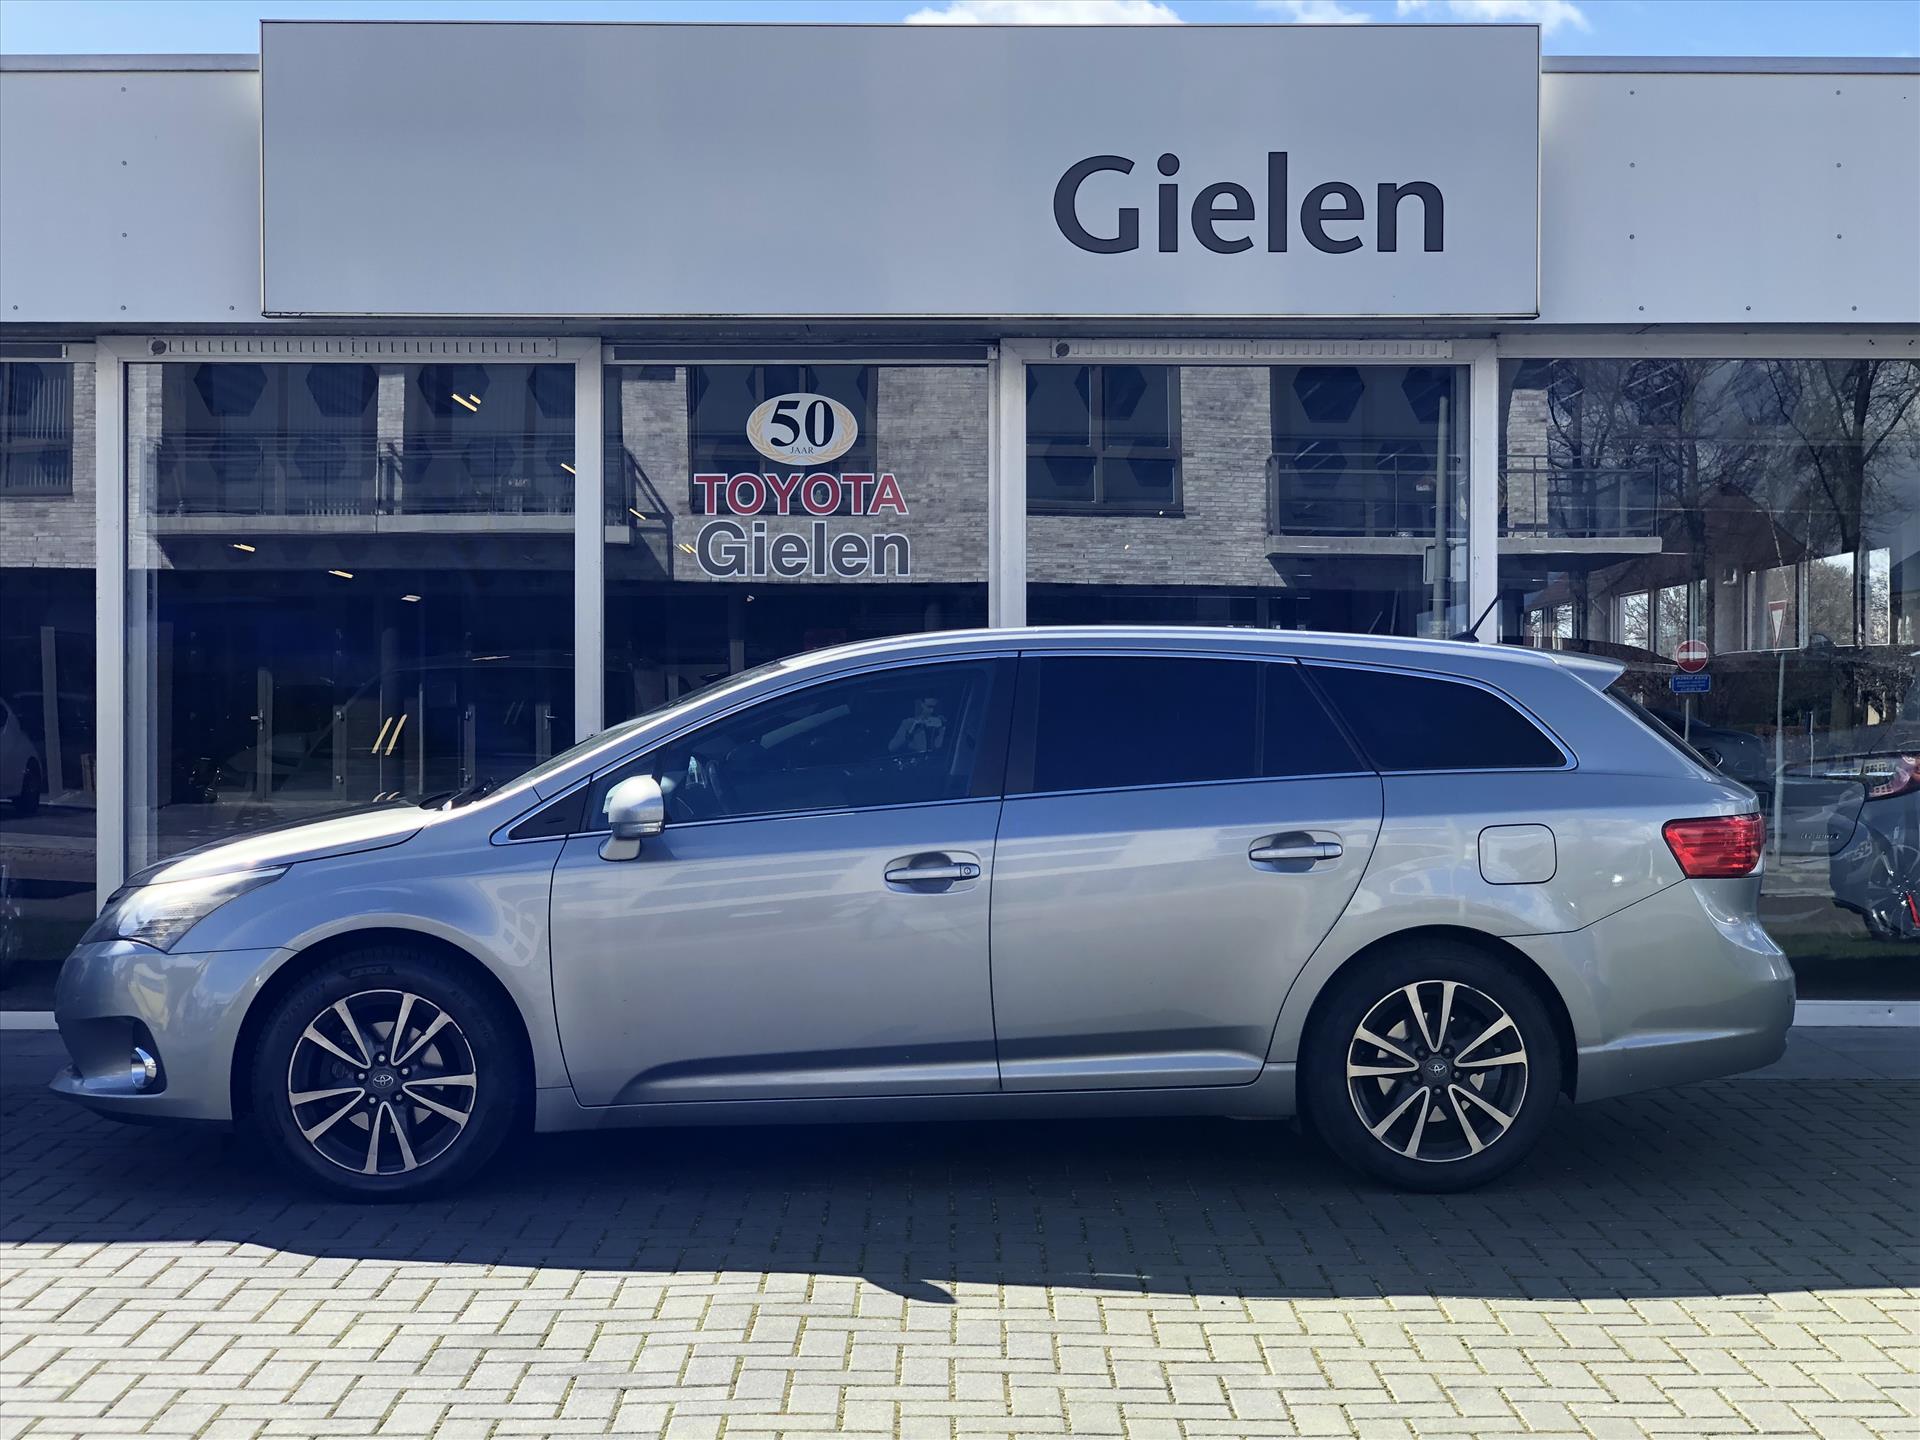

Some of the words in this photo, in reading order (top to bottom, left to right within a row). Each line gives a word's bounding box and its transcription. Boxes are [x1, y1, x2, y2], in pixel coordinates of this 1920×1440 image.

[1053, 151, 1444, 254] Gielen
[770, 399, 835, 447] 50
[790, 446, 815, 454] JAAR
[694, 473, 909, 516] TOYOTA
[696, 520, 911, 578] Gielen
